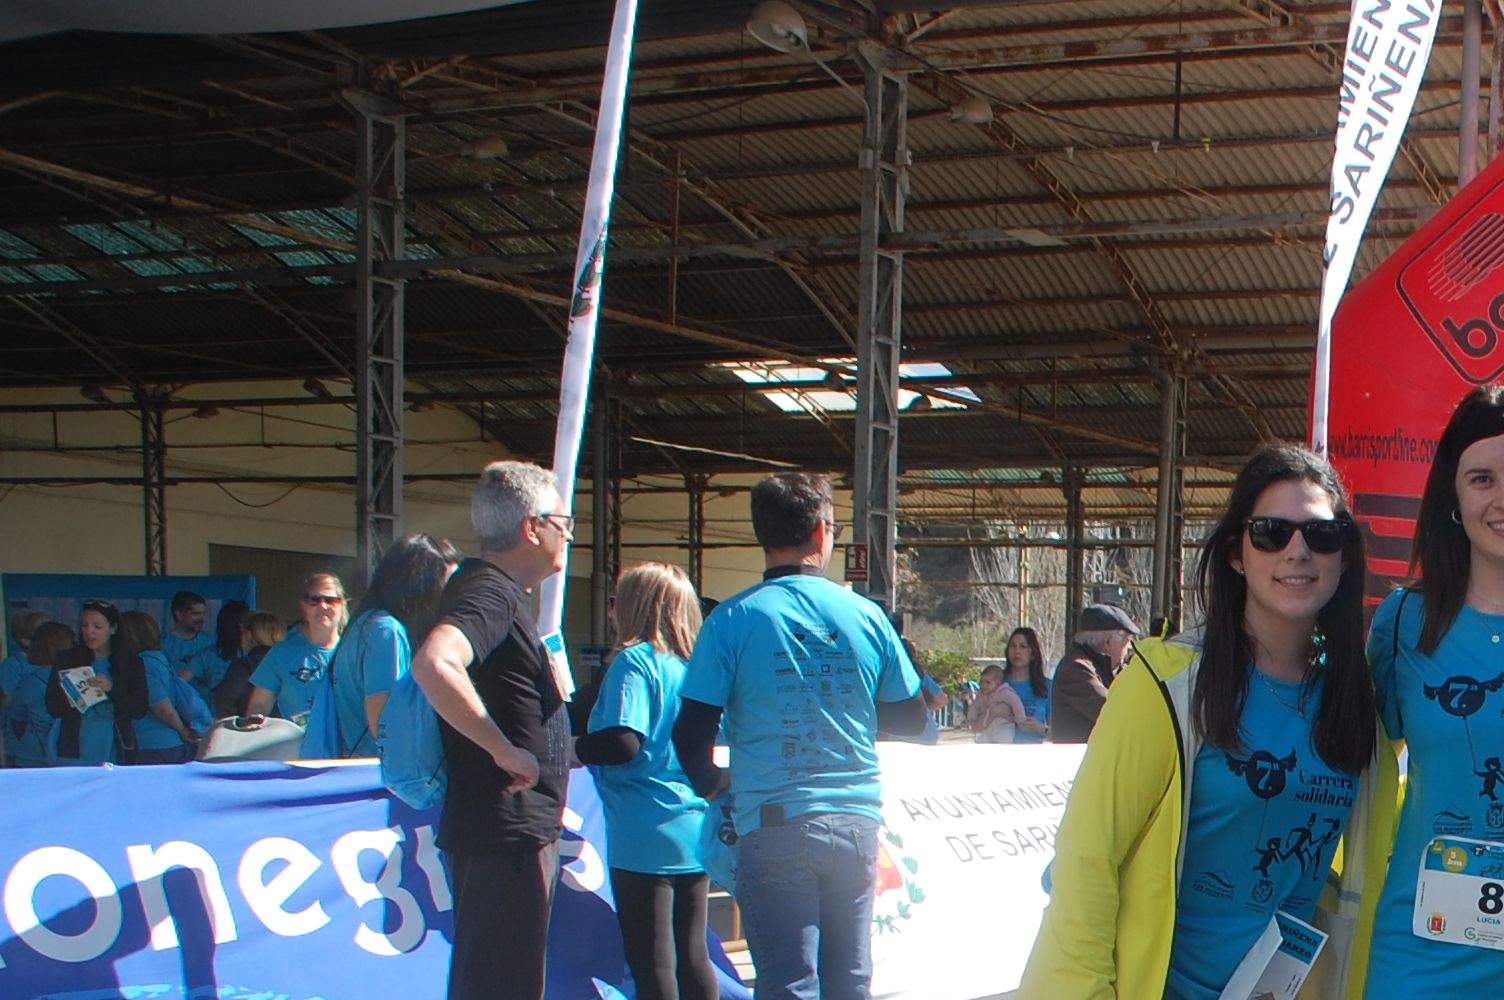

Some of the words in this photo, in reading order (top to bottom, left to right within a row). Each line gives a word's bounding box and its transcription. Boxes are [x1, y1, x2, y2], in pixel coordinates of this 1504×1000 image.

[945, 833, 994, 863] DE
[1478, 882, 1504, 915] 8
[1476, 916, 1501, 926] LUCIA
